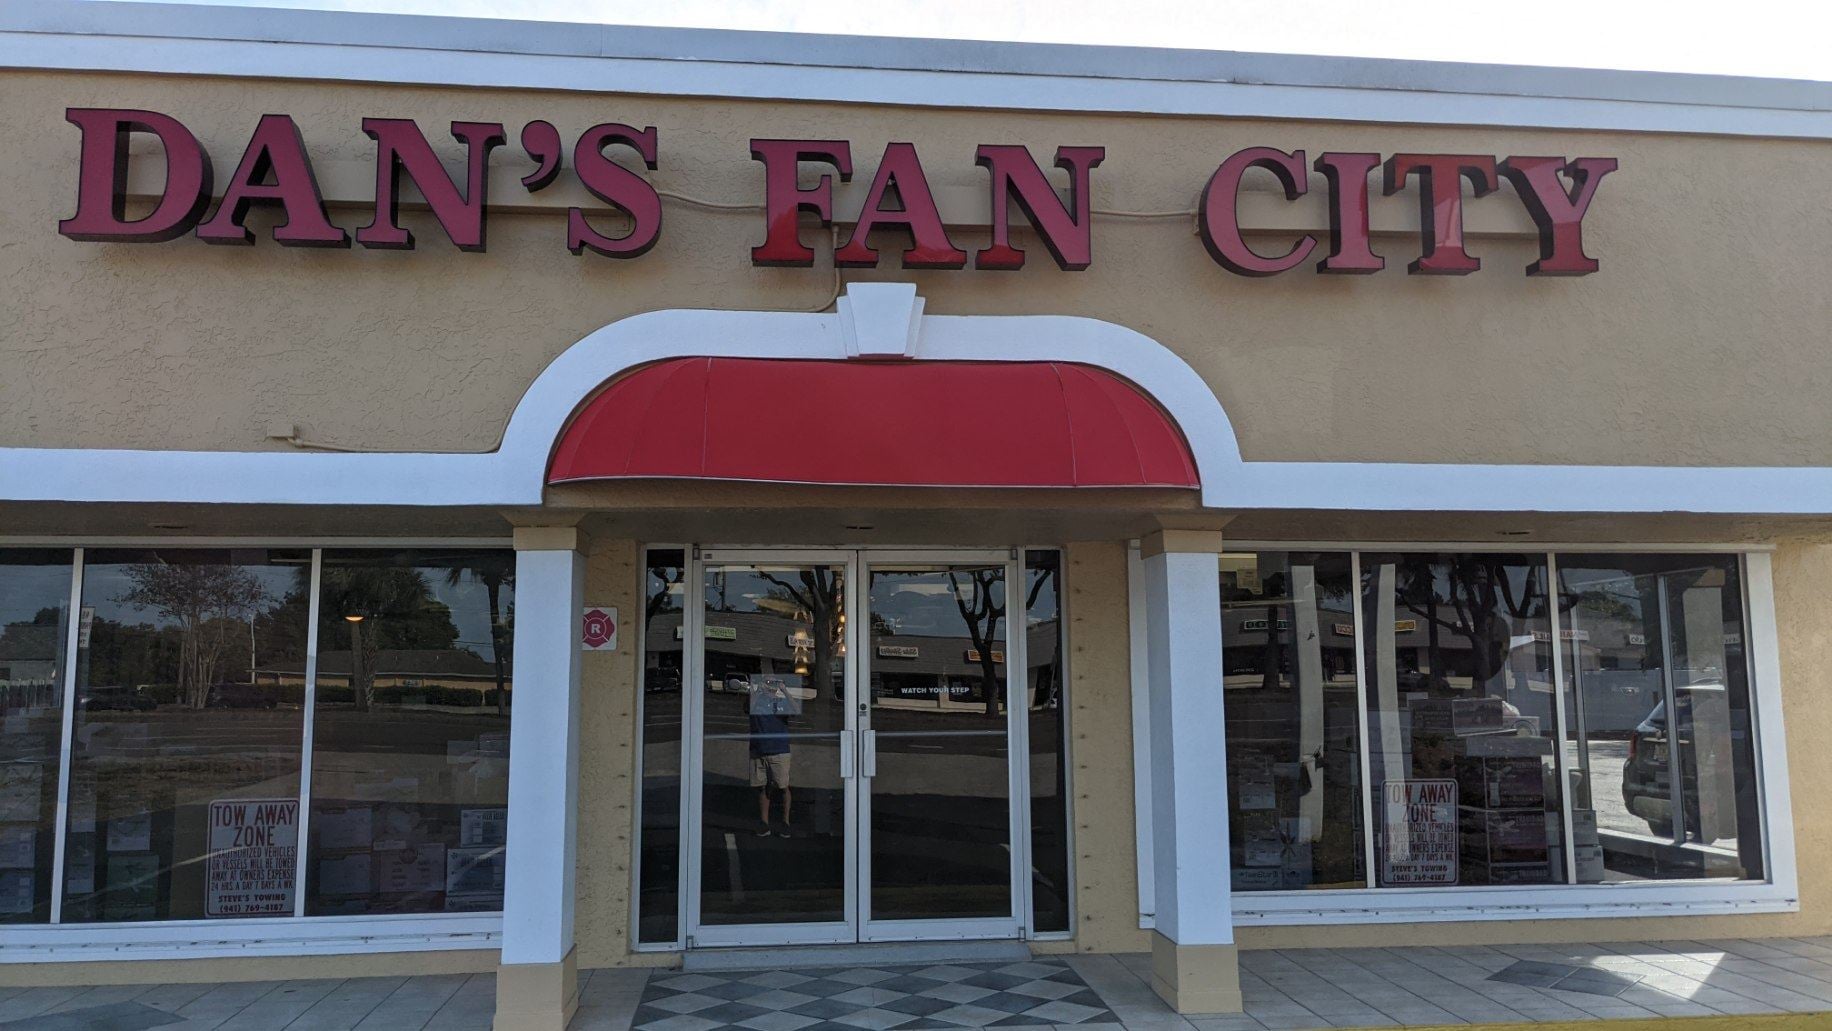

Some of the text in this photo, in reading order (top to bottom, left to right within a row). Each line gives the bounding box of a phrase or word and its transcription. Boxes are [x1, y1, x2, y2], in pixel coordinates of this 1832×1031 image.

[58, 107, 1619, 277] DAN'S FAN CITY
[591, 624, 601, 633] R
[1385, 784, 1453, 803] TOW AWAY
[214, 804, 296, 826] TOW AWAY
[1402, 803, 1437, 823] ZONE
[233, 826, 276, 847] ZONE
[265, 846, 296, 858] VEHICLES
[223, 858, 248, 870] VESSELS
[1391, 865, 1418, 873] STEVE'S
[267, 869, 295, 880] EXPENSE
[218, 893, 287, 903] STEVE'S TOWING
